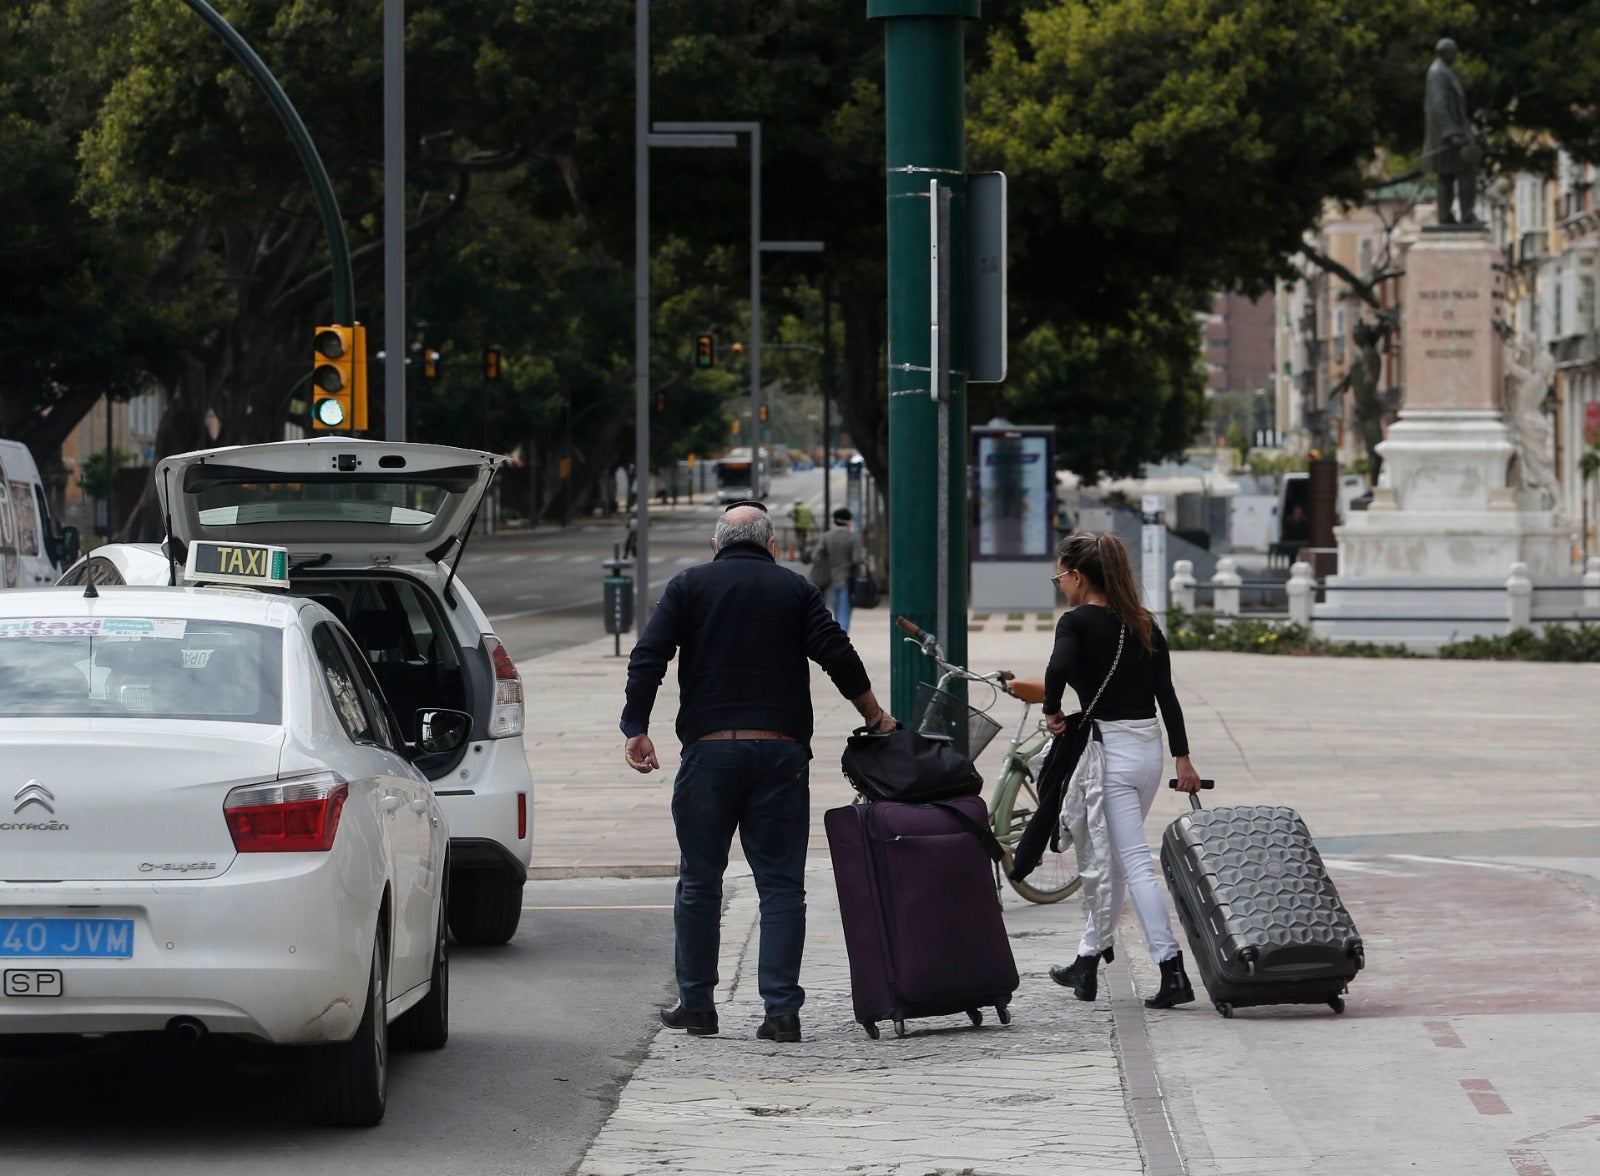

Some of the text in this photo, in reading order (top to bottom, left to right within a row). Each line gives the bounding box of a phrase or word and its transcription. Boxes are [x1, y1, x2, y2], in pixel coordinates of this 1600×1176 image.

[217, 547, 267, 576] TAXI
[3, 922, 128, 953] 40 JVM
